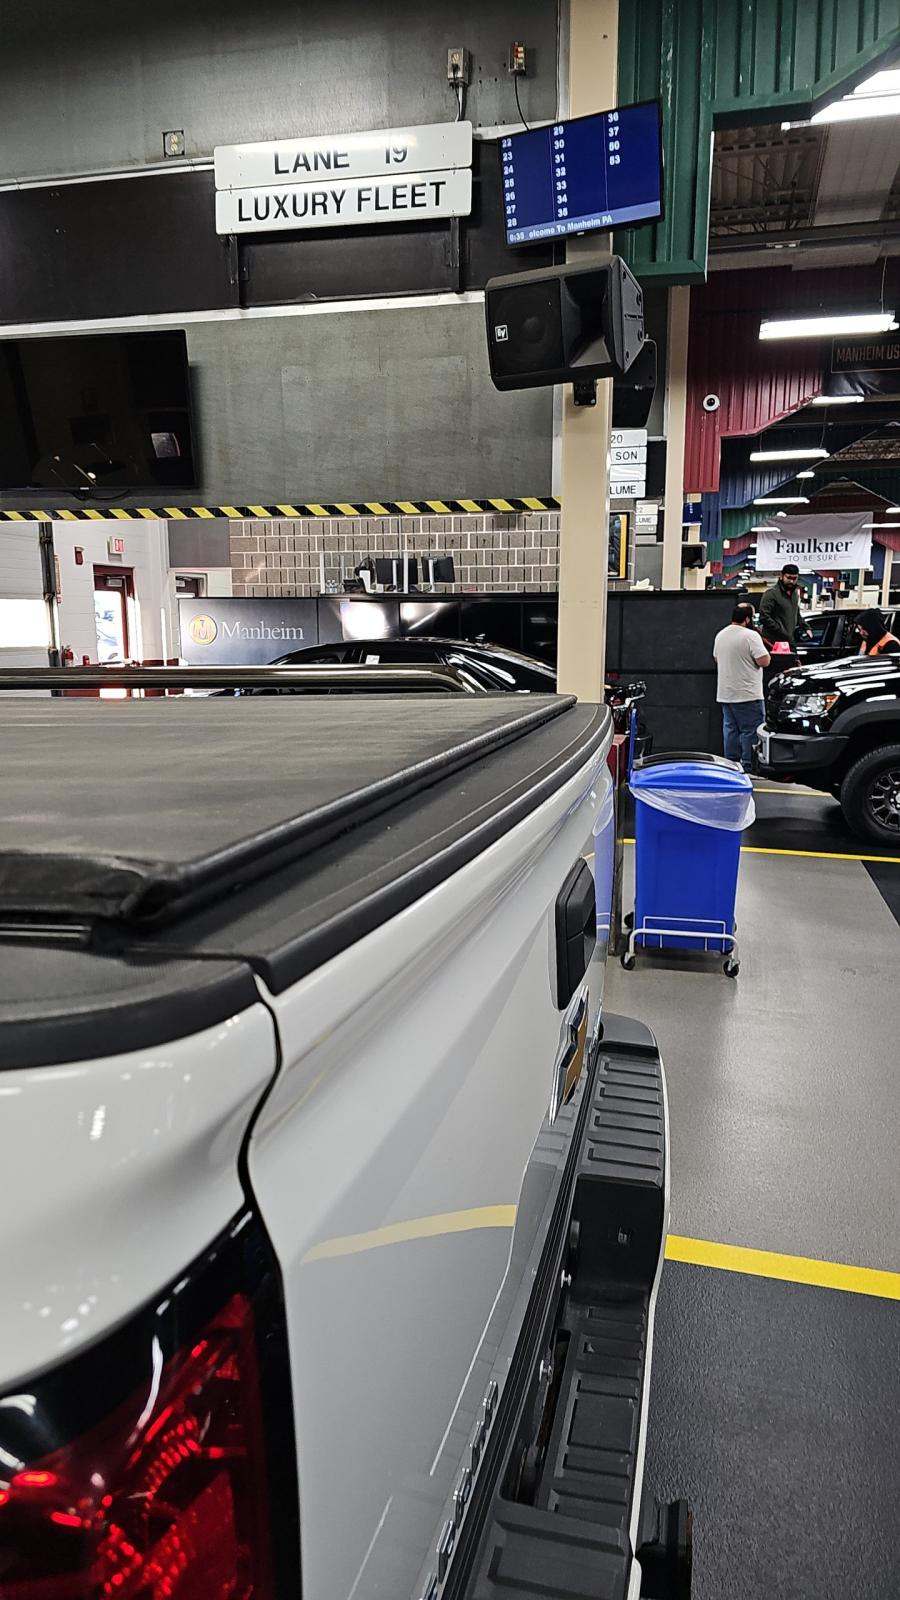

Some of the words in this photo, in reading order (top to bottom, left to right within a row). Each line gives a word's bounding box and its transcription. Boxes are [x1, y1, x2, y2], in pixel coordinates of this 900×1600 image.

[608, 126, 619, 137] 37
[502, 138, 512, 148] 22
[554, 139, 565, 150] 30
[274, 148, 350, 174] LANE
[384, 145, 408, 164] 19
[503, 151, 513, 161] 23
[555, 153, 565, 163] 31
[504, 165, 514, 175] 24
[556, 167, 566, 177] 32
[556, 181, 567, 191] 33
[238, 189, 346, 222] LUXURY
[357, 181, 446, 212] FLEET
[505, 191, 516, 202] 26
[557, 194, 568, 204] 34
[506, 205, 516, 215] 27
[507, 218, 517, 228] 28
[556, 224, 566, 233] To
[602, 214, 613, 224] PA
[836, 344, 883, 363] MANHEIM
[610, 434, 623, 443] 20
[615, 451, 638, 461] SON
[610, 485, 636, 495] LUME
[776, 538, 852, 554] Faulkner
[817, 553, 838, 561] SURE
[221, 621, 304, 640] Manheim
